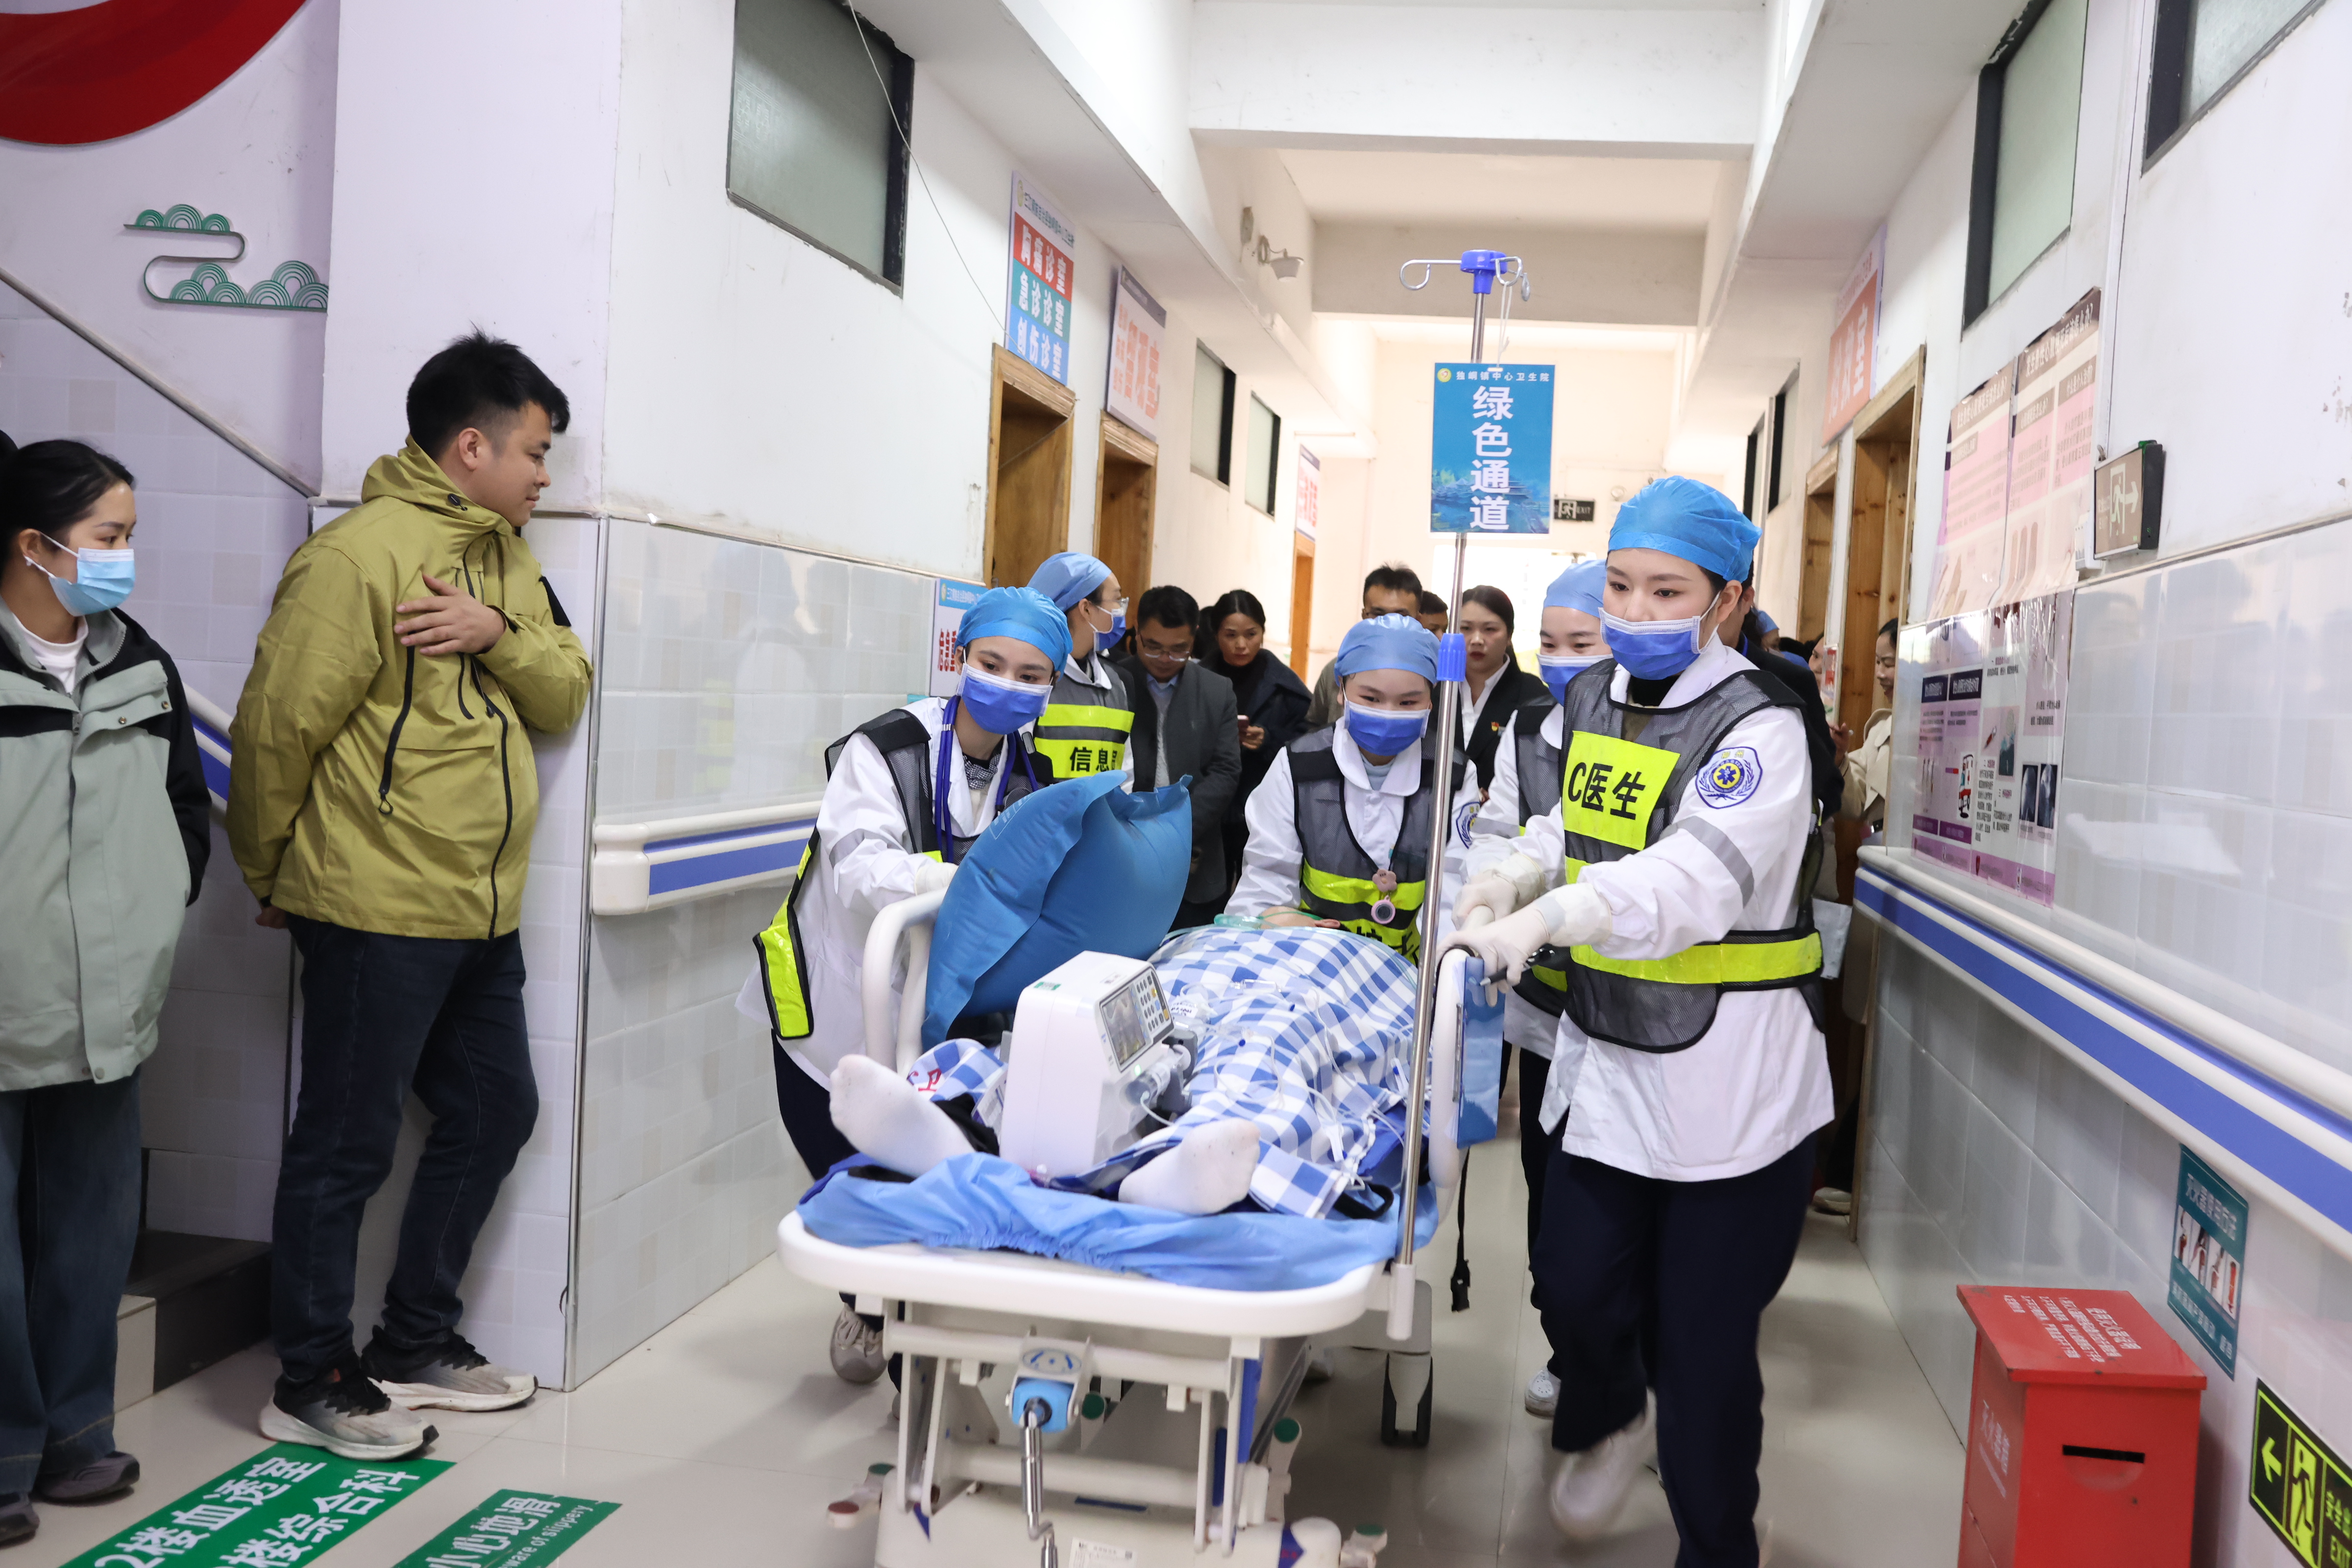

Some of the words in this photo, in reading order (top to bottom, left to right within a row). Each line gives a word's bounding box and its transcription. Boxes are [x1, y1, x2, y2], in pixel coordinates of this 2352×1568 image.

[1019, 270, 1064, 337] 急诊诊室
[1017, 316, 1062, 379] 创伤诊室
[1456, 371, 1549, 382] 独峒镇中心卫生院
[1470, 386, 1514, 530] 绿色通道
[1568, 762, 1646, 820] C医生
[94, 1457, 327, 1568] 2楼血透室
[219, 1469, 419, 1568] 楼综合科
[425, 1497, 561, 1568] 小心地滑
[497, 1547, 538, 1568] ware
[531, 1536, 549, 1546] of
[541, 1505, 593, 1537] slippery
